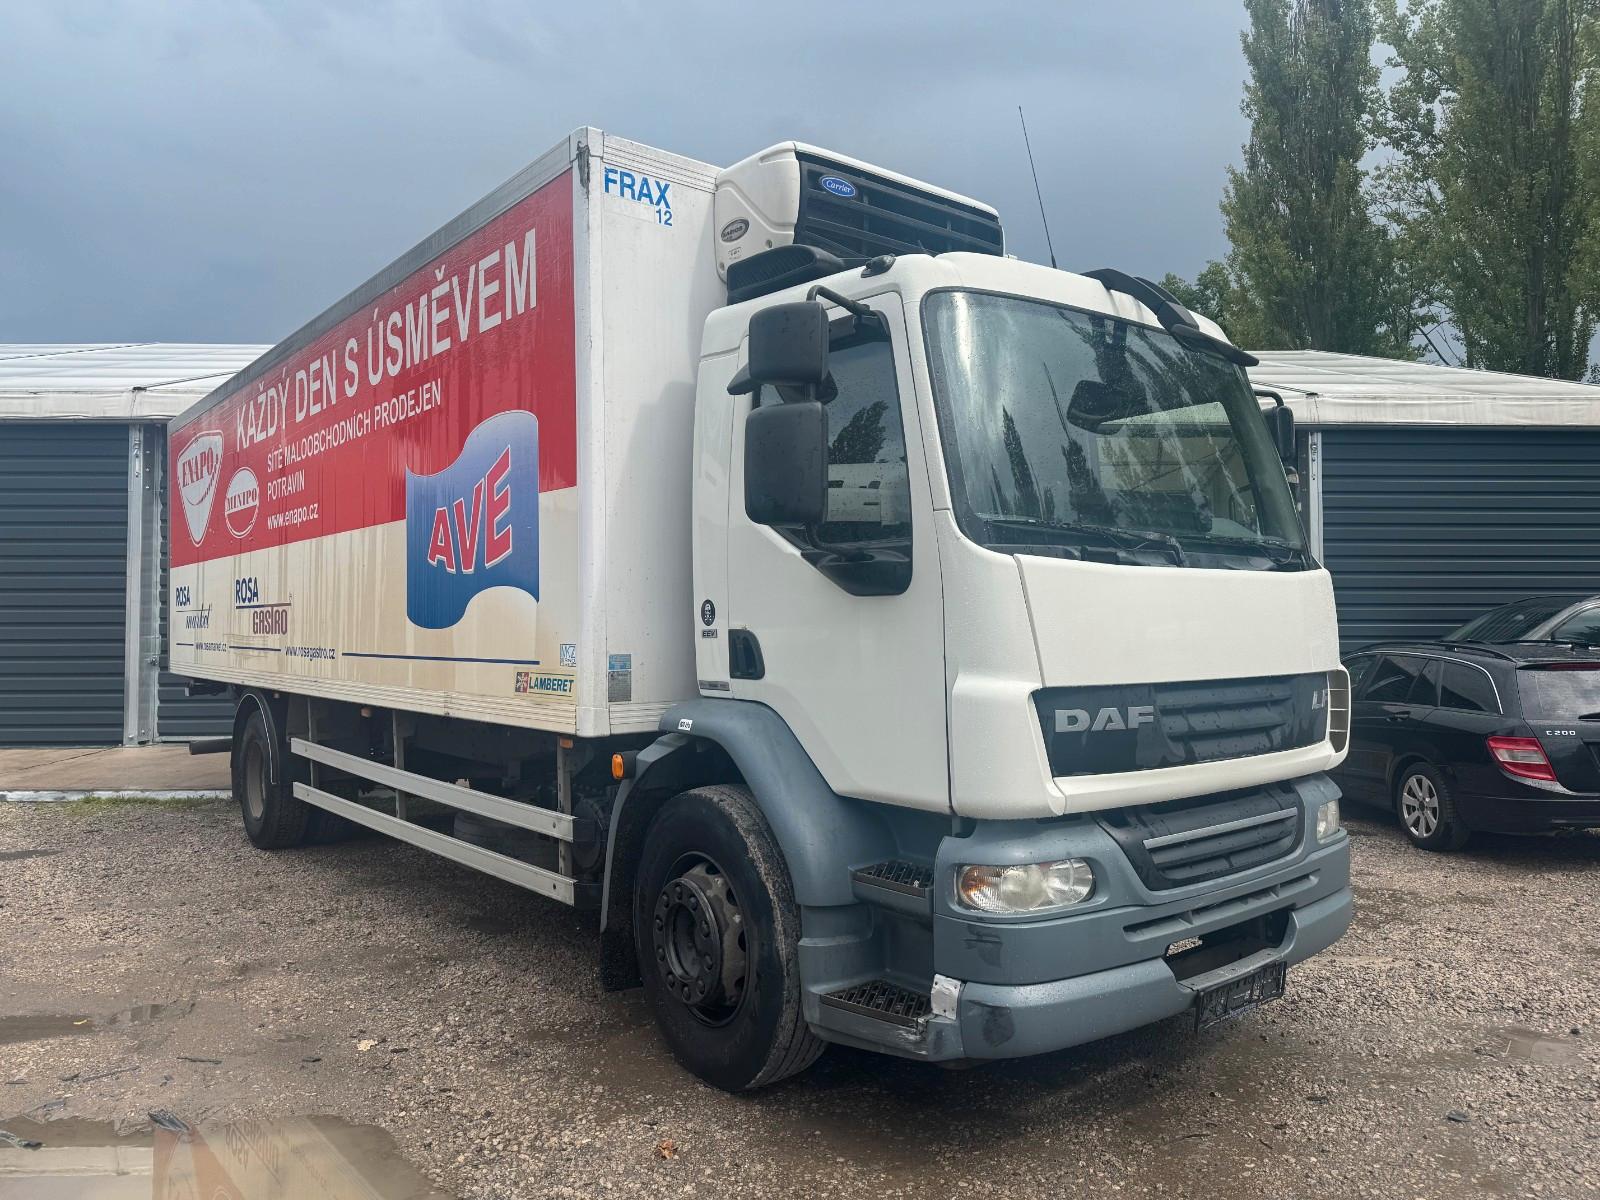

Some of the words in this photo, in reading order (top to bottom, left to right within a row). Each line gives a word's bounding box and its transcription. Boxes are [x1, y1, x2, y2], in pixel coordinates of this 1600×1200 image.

[604, 166, 671, 210] FRAX
[826, 179, 851, 193] Carrier
[656, 208, 673, 227] 12
[236, 367, 290, 452] KAŽDÝ
[295, 350, 337, 424] DEN
[344, 337, 359, 398] S
[367, 228, 537, 386] ÚSMĚVEM
[267, 446, 283, 473] SÍTĚ
[284, 410, 371, 469] MALOOBCHODNÍCH
[374, 378, 441, 429] PRODEJEN
[182, 447, 214, 489] ENAPO
[227, 487, 257, 512] MINIPO
[267, 469, 305, 502] POTRAVIN
[267, 502, 319, 530] www.enapo.cz
[428, 444, 513, 575] AVE
[175, 586, 191, 607] ROSA
[236, 577, 259, 604] ROSA
[252, 606, 288, 636] GASTRO
[285, 646, 336, 661] www.rosagastro.cz
[529, 676, 574, 693] LAMBERET
[1054, 705, 1154, 733] DAF
